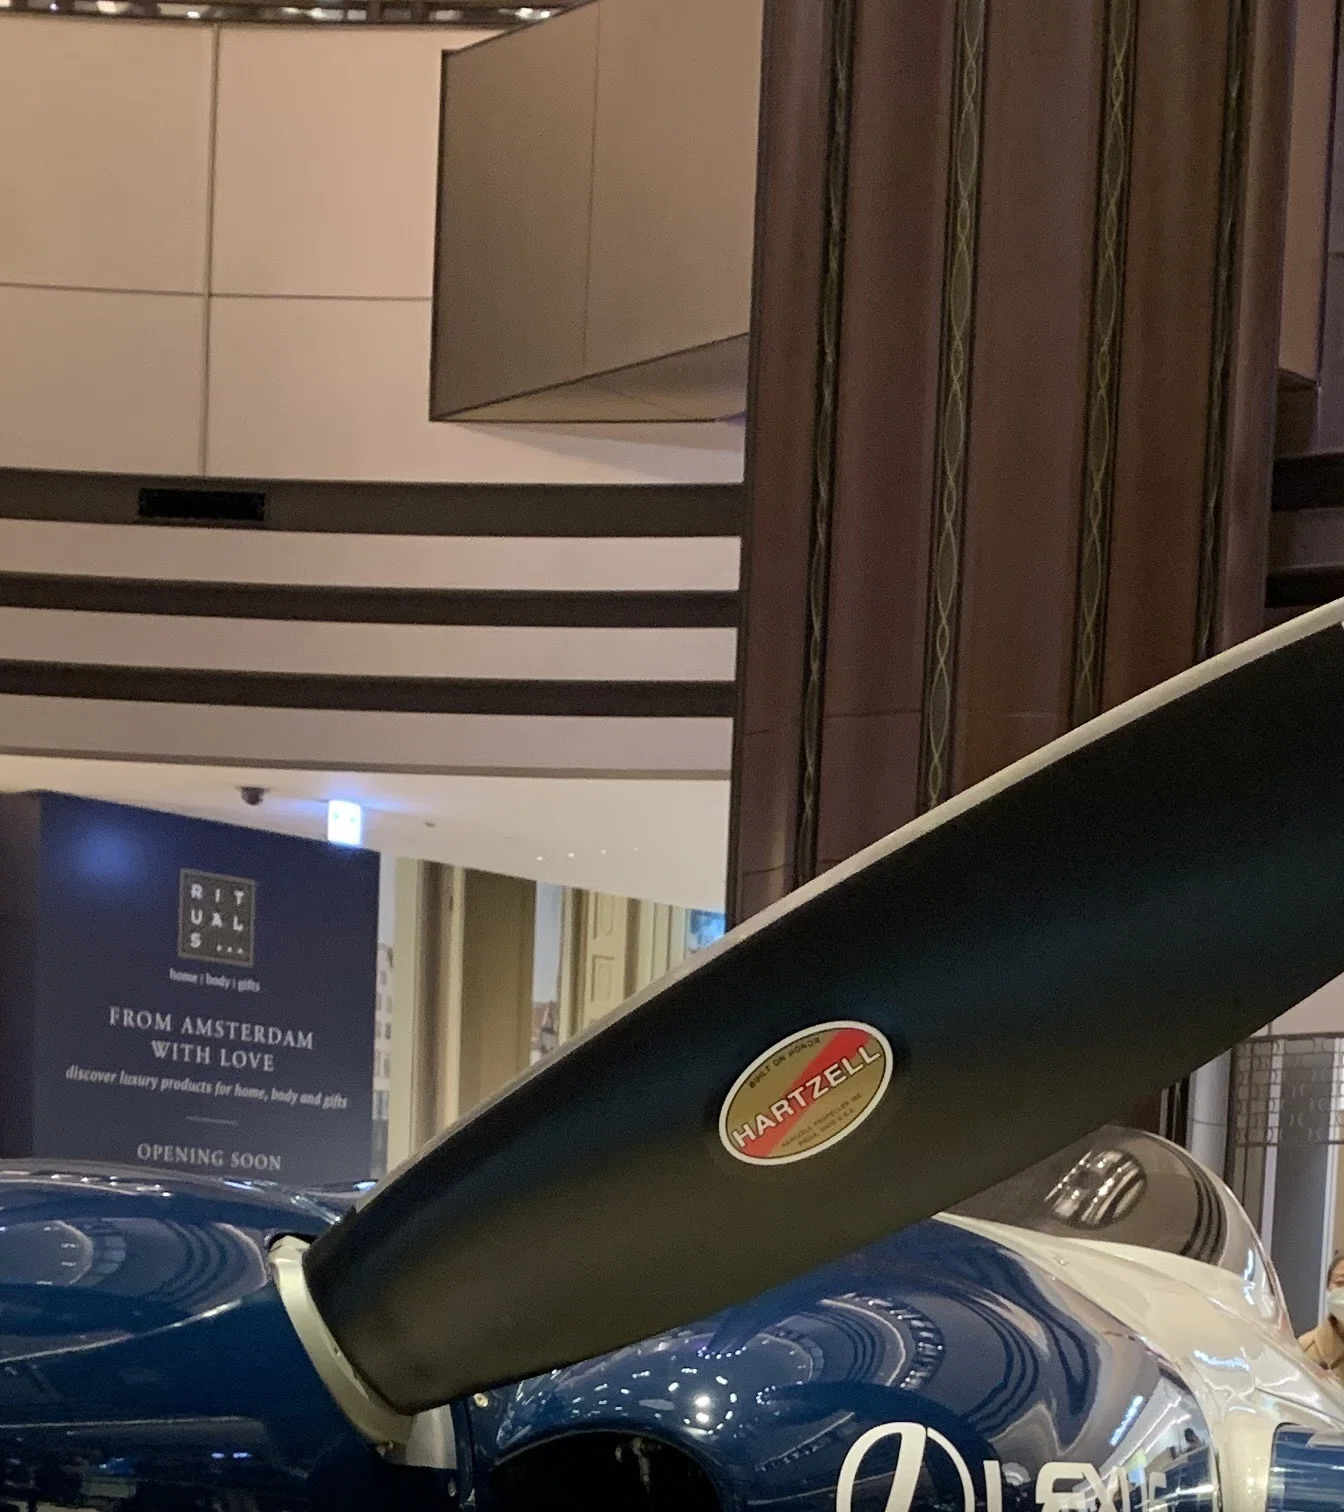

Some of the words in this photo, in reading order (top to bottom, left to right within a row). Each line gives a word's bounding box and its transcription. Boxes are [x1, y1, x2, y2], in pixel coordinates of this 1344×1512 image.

[169, 968, 198, 985] home
[205, 973, 231, 991] body
[237, 977, 260, 993] gifts
[109, 1006, 173, 1033] FROM
[180, 1016, 315, 1050] AMSTERDAM
[150, 1040, 212, 1066] WITH
[220, 1050, 276, 1072] LOVE
[65, 1065, 117, 1084] discover
[119, 1070, 158, 1091] luxury
[160, 1076, 213, 1097] products
[215, 1081, 233, 1098] for
[234, 1084, 268, 1102] home,
[270, 1087, 298, 1107] body
[300, 1091, 320, 1106] and
[321, 1093, 348, 1111] gifts
[731, 1046, 881, 1148] HARTZELL
[136, 1143, 224, 1168] OPENING
[230, 1150, 282, 1171] SOON
